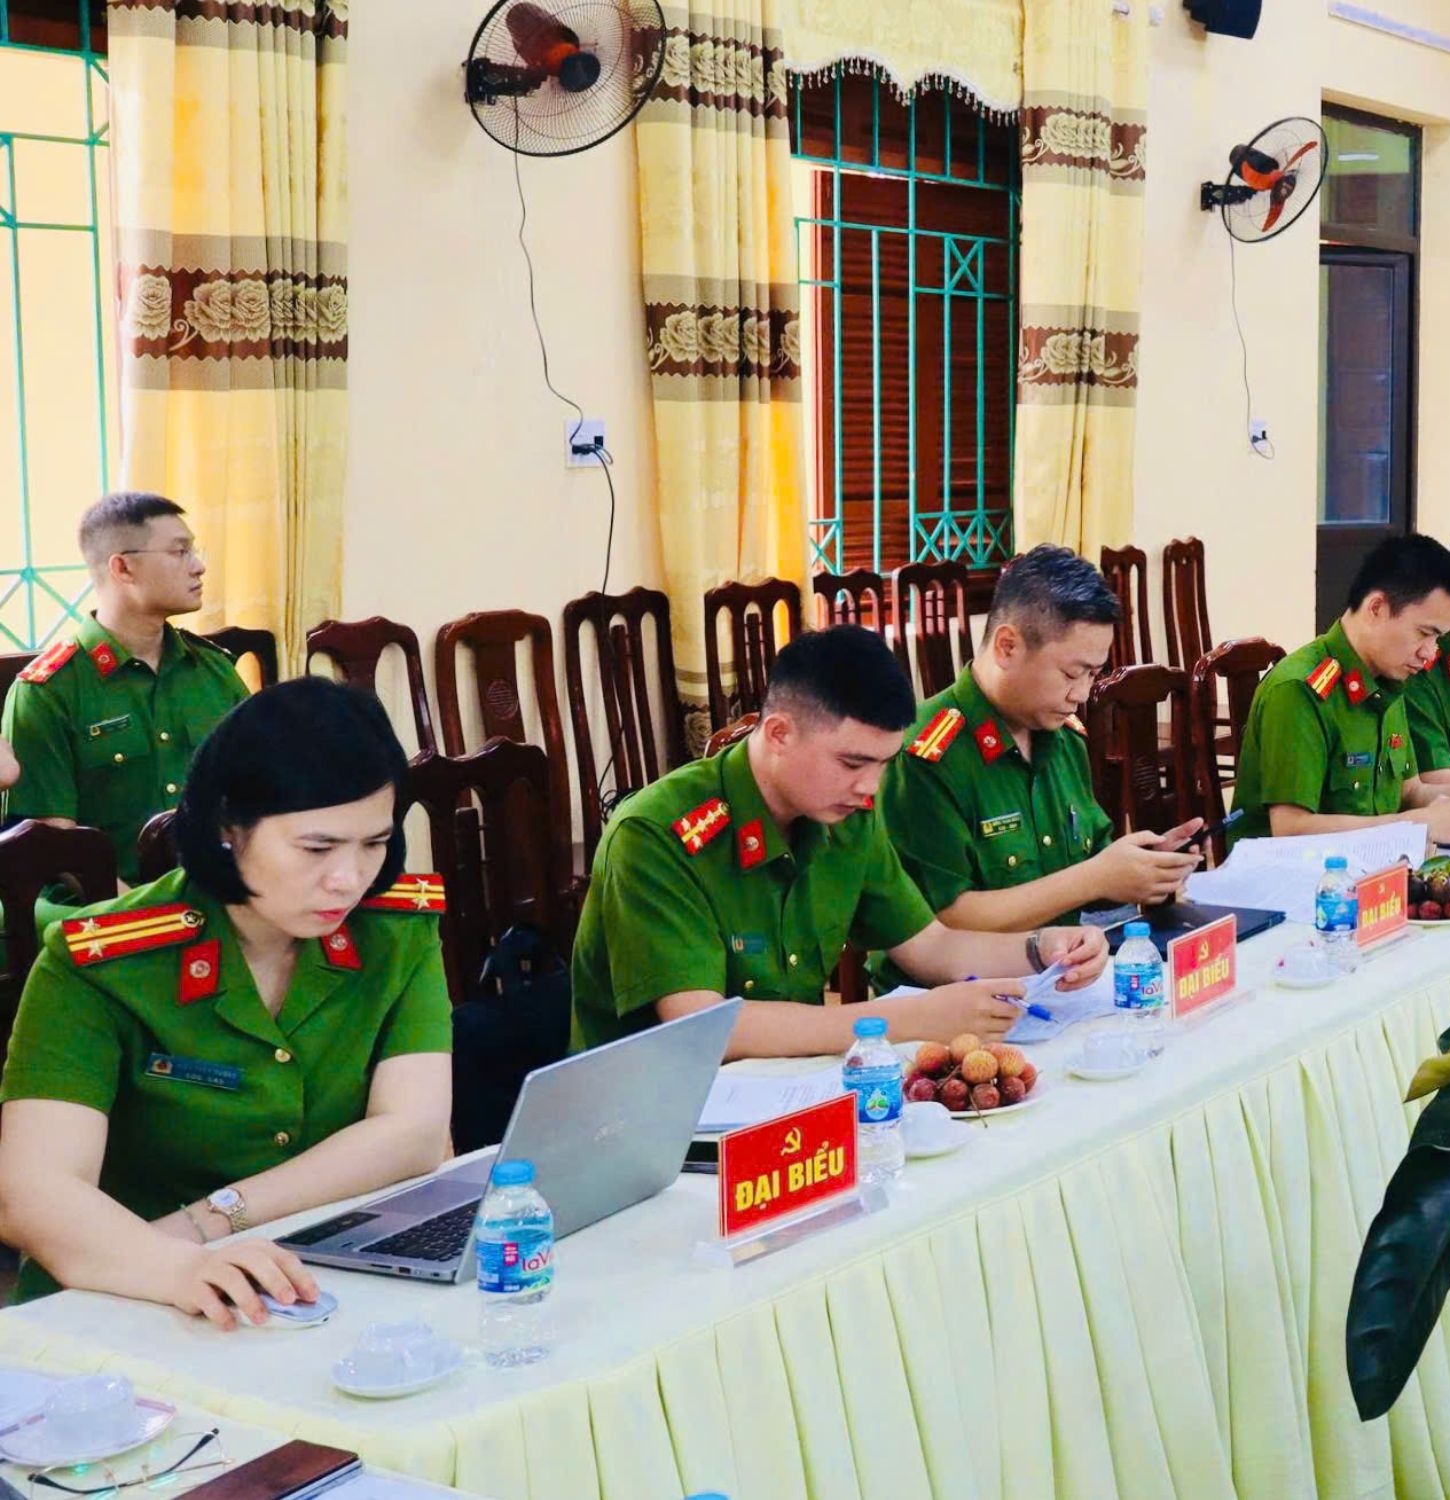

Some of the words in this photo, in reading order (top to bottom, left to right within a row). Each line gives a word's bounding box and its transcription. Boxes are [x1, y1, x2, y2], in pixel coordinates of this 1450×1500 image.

[1179, 970, 1200, 1000] ĐẠI
[735, 1169, 780, 1212] ĐẠI
[788, 1140, 845, 1193] BIỂU
